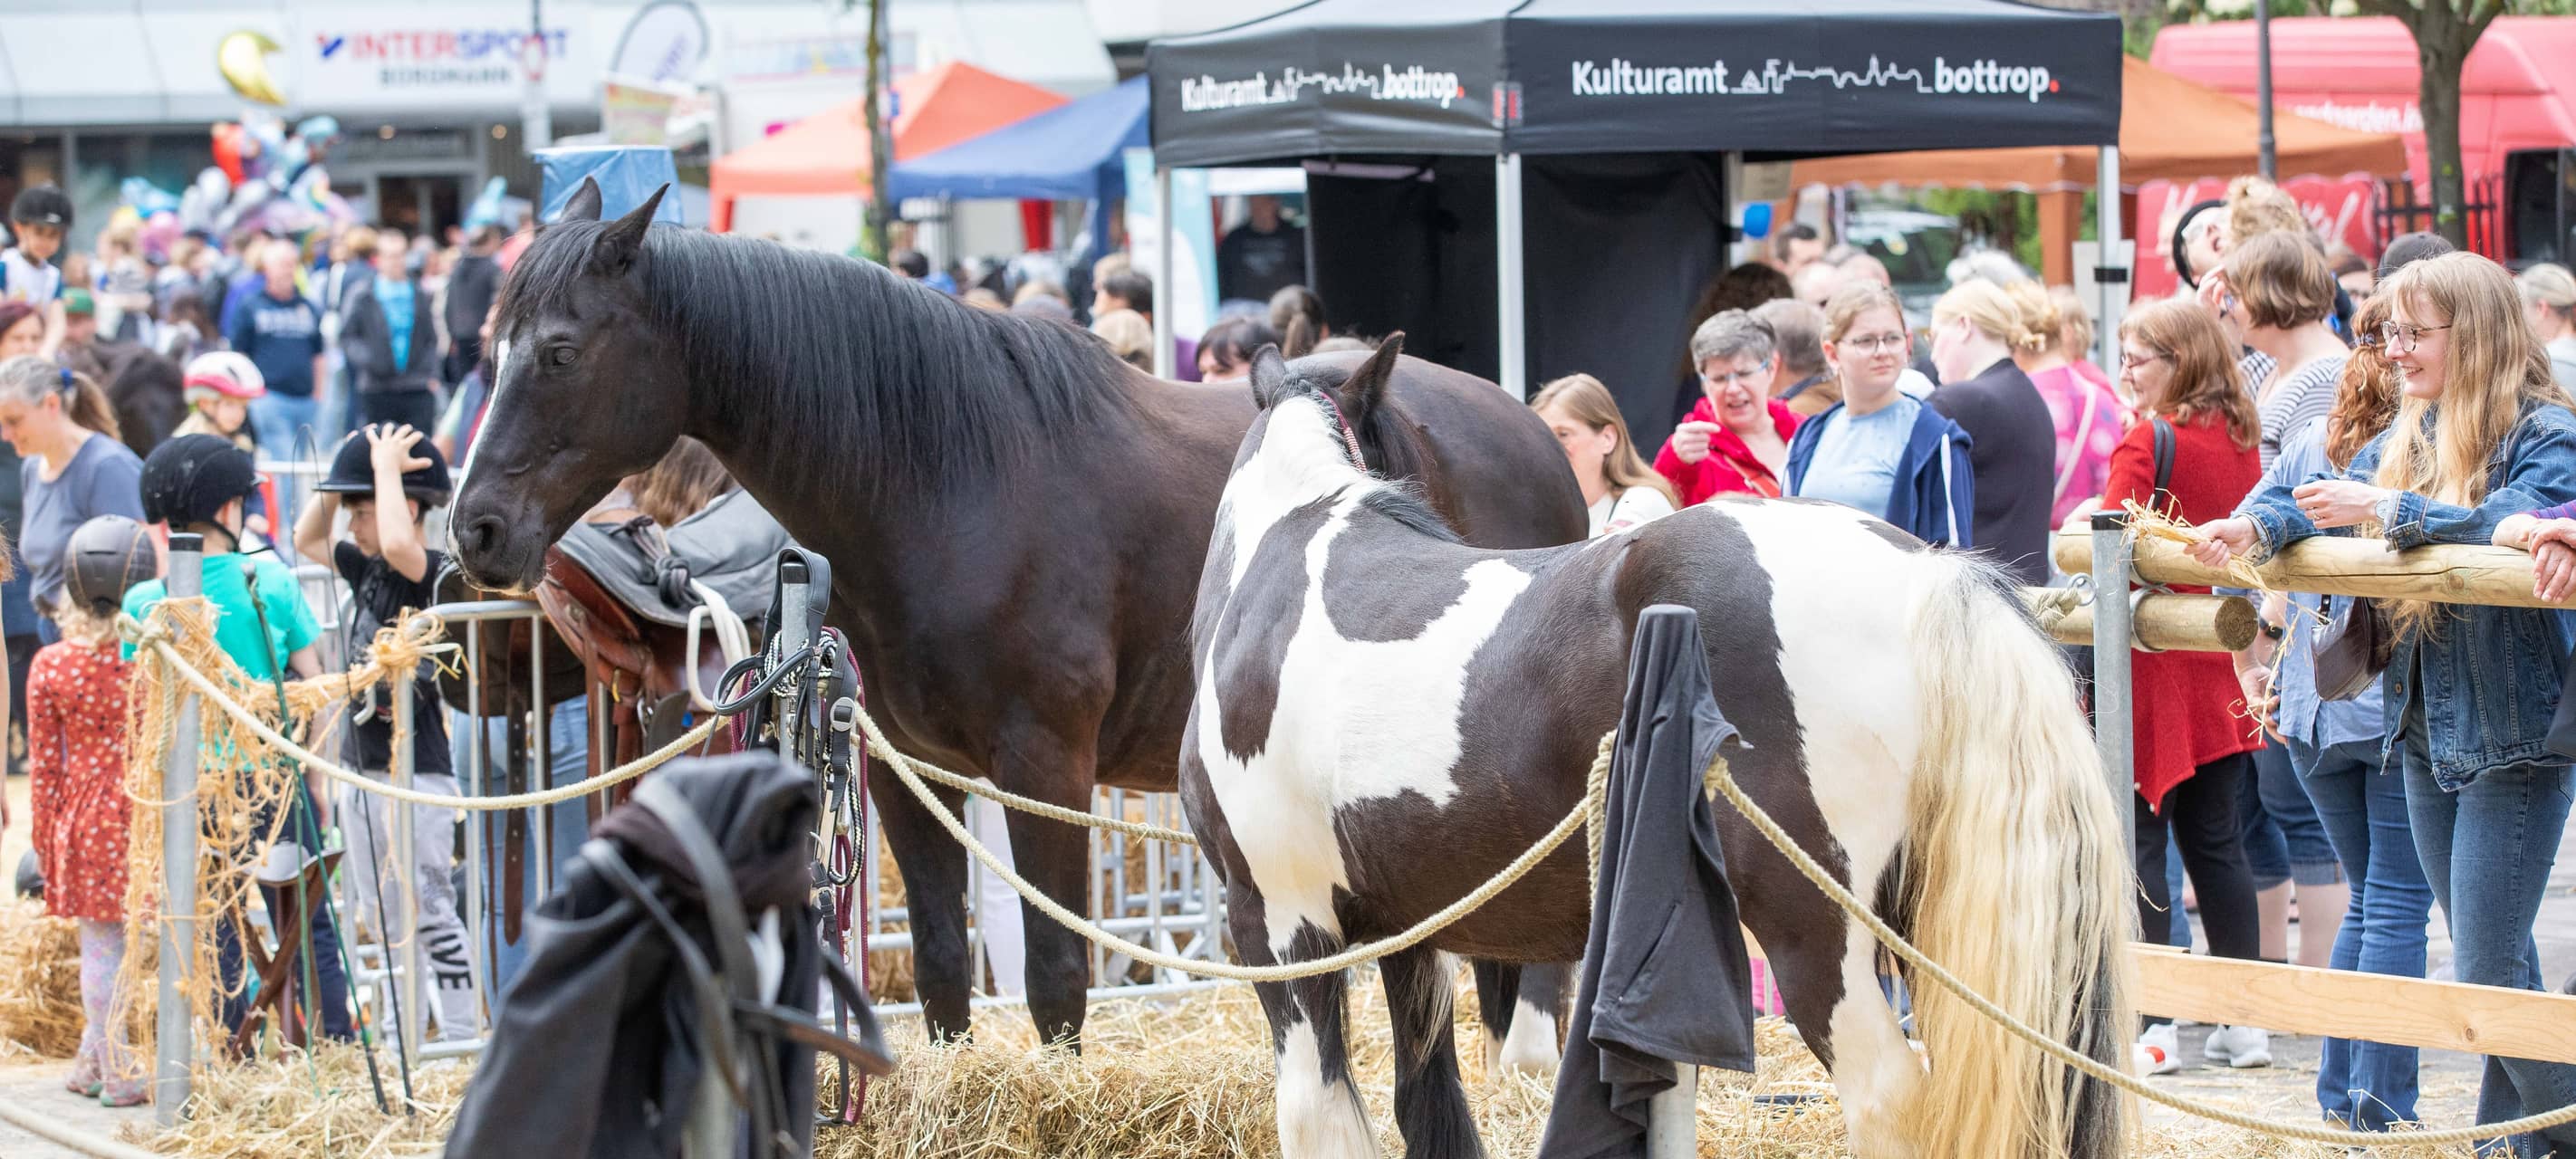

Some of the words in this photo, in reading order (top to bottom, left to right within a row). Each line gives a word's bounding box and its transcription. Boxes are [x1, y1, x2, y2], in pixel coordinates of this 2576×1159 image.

[1181, 71, 1267, 111] Kulturamt
[1382, 62, 1465, 109] bottrop.
[1572, 57, 1729, 95] Kulturamt
[1934, 56, 2060, 103] bottrop.
